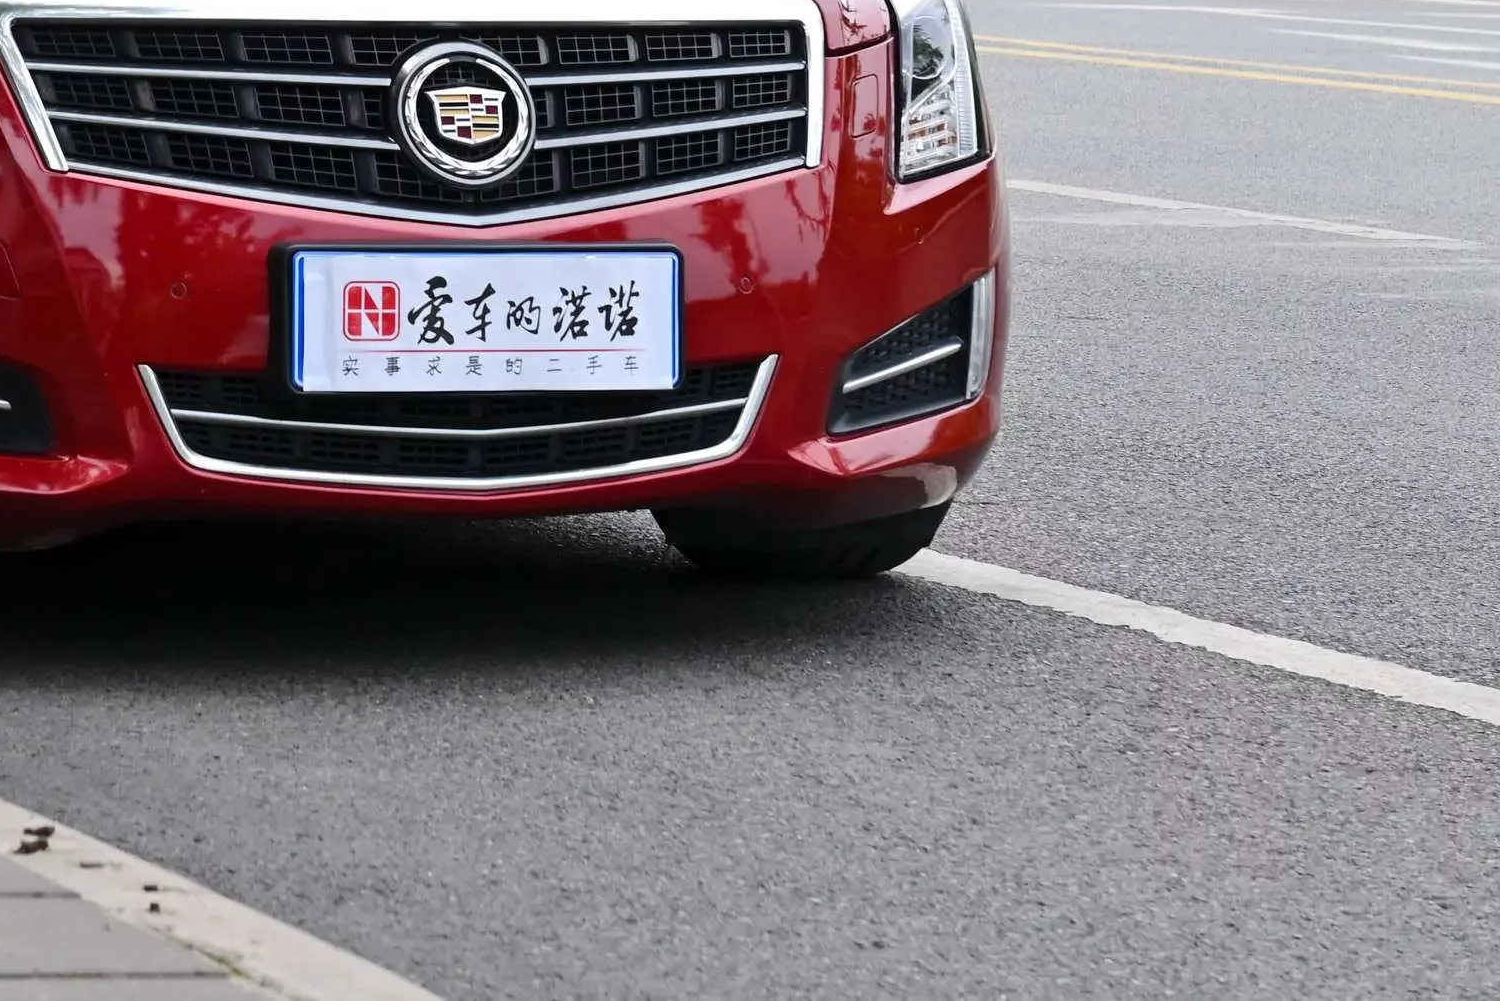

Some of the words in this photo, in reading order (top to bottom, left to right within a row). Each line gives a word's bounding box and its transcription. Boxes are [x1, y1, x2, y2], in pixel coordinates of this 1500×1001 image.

[342, 355, 639, 376] 实事求是的二手车
